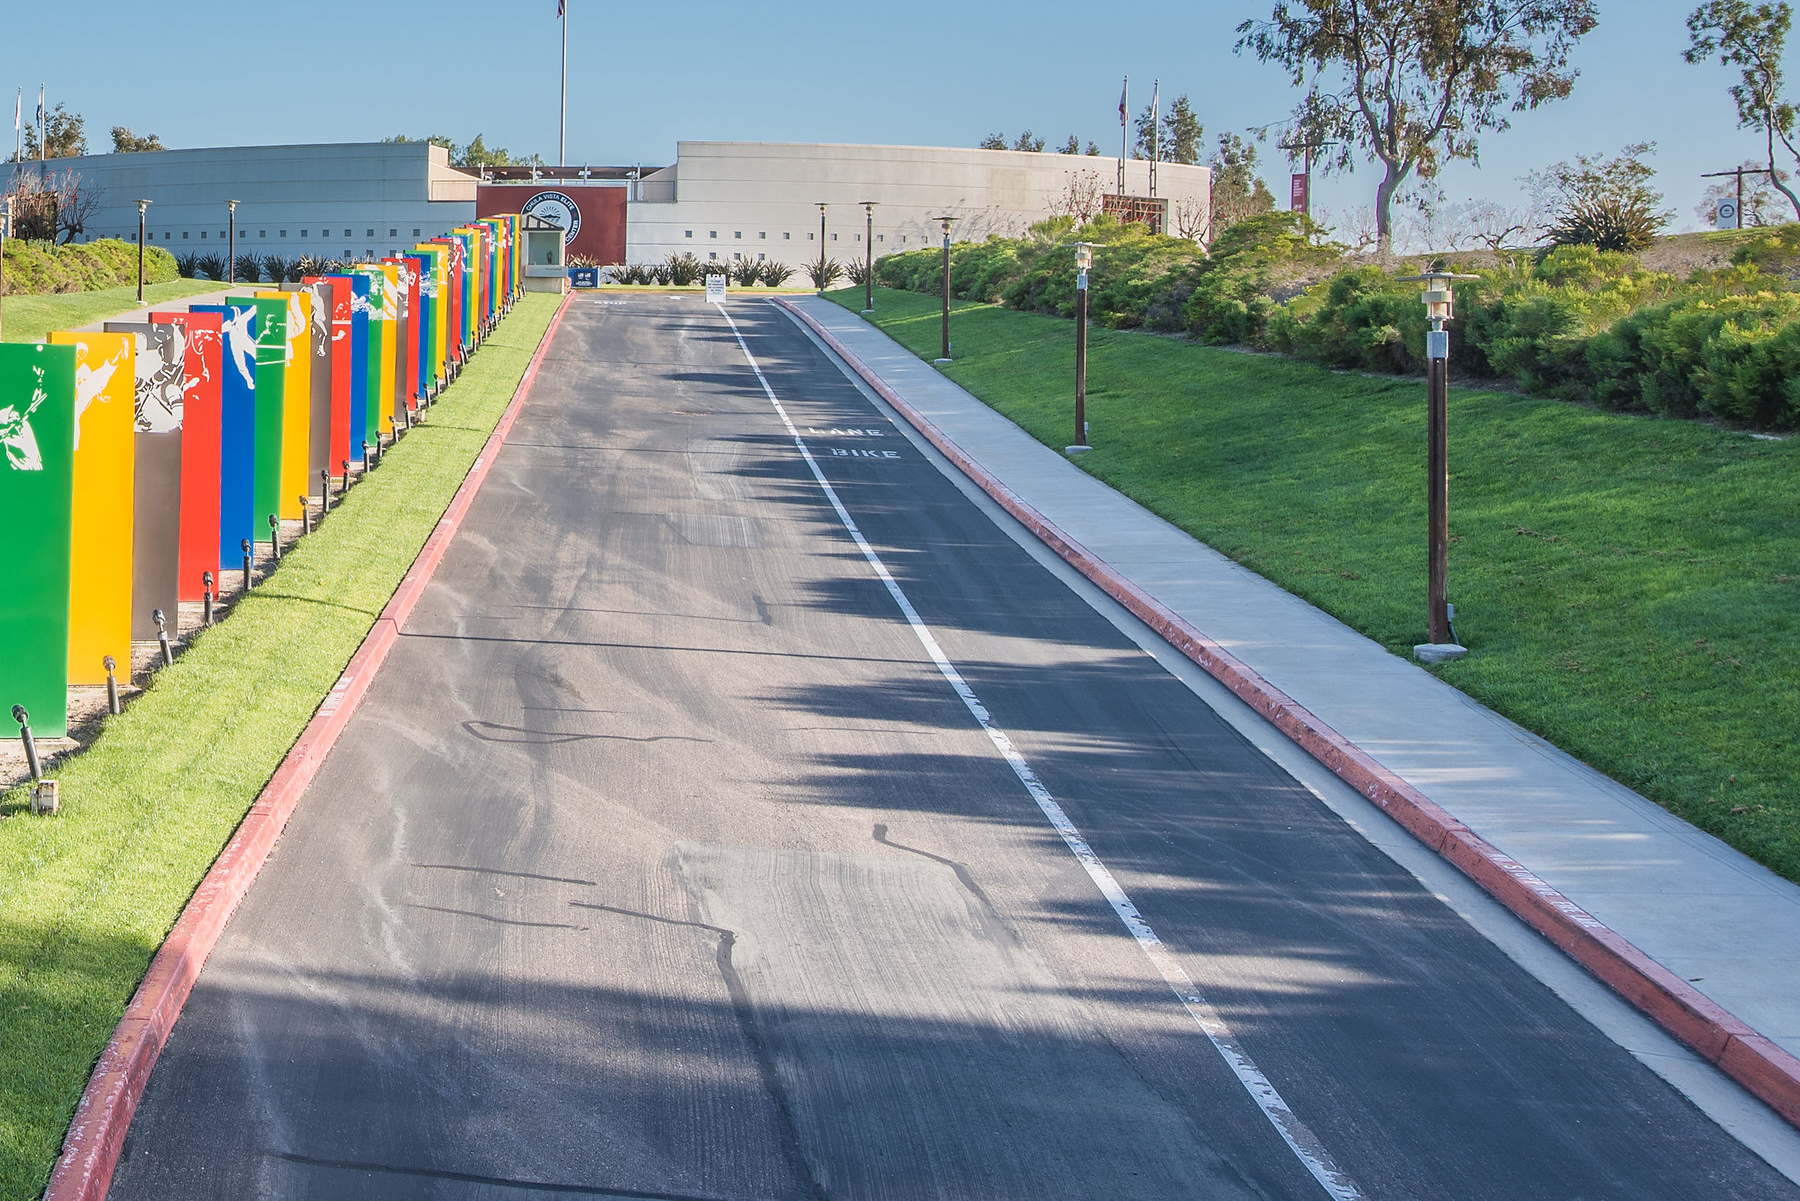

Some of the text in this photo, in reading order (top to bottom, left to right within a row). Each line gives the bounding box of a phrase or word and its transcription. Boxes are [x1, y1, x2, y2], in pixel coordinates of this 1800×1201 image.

[525, 195, 543, 212] CHULA
[560, 196, 575, 211] ELITE
[808, 427, 885, 437] LANE
[830, 448, 902, 459] BIKE
